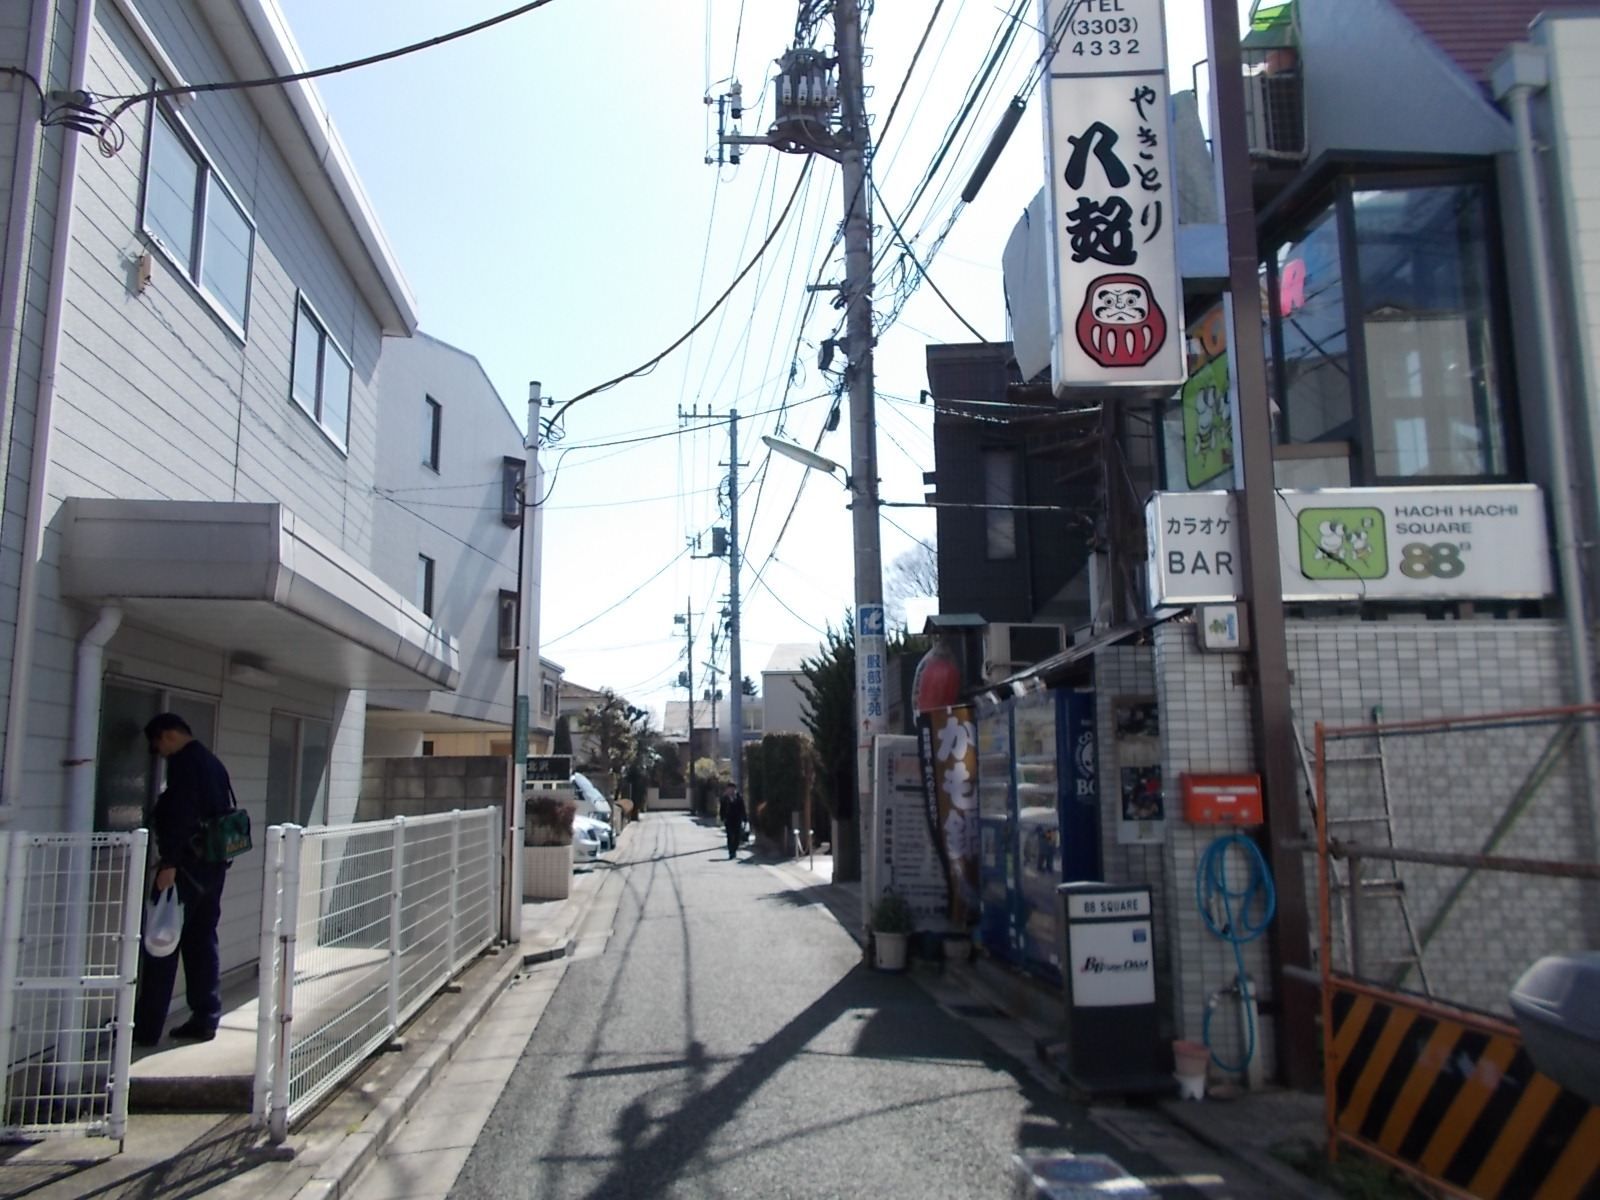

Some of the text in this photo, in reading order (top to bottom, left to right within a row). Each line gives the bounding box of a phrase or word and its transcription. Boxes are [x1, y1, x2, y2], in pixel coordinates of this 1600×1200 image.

[1083, 0, 1125, 13] TEL
[1071, 16, 1138, 36] (3303)
[1072, 39, 1140, 56] 4332
[1129, 85, 1162, 243] やきとり
[1395, 505, 1519, 518] HACHI HACHI
[1167, 516, 1231, 535] カラオケ
[1395, 521, 1472, 535] SQUARE
[1168, 550, 1234, 575] BAR
[1100, 898, 1139, 912] SQUARE
